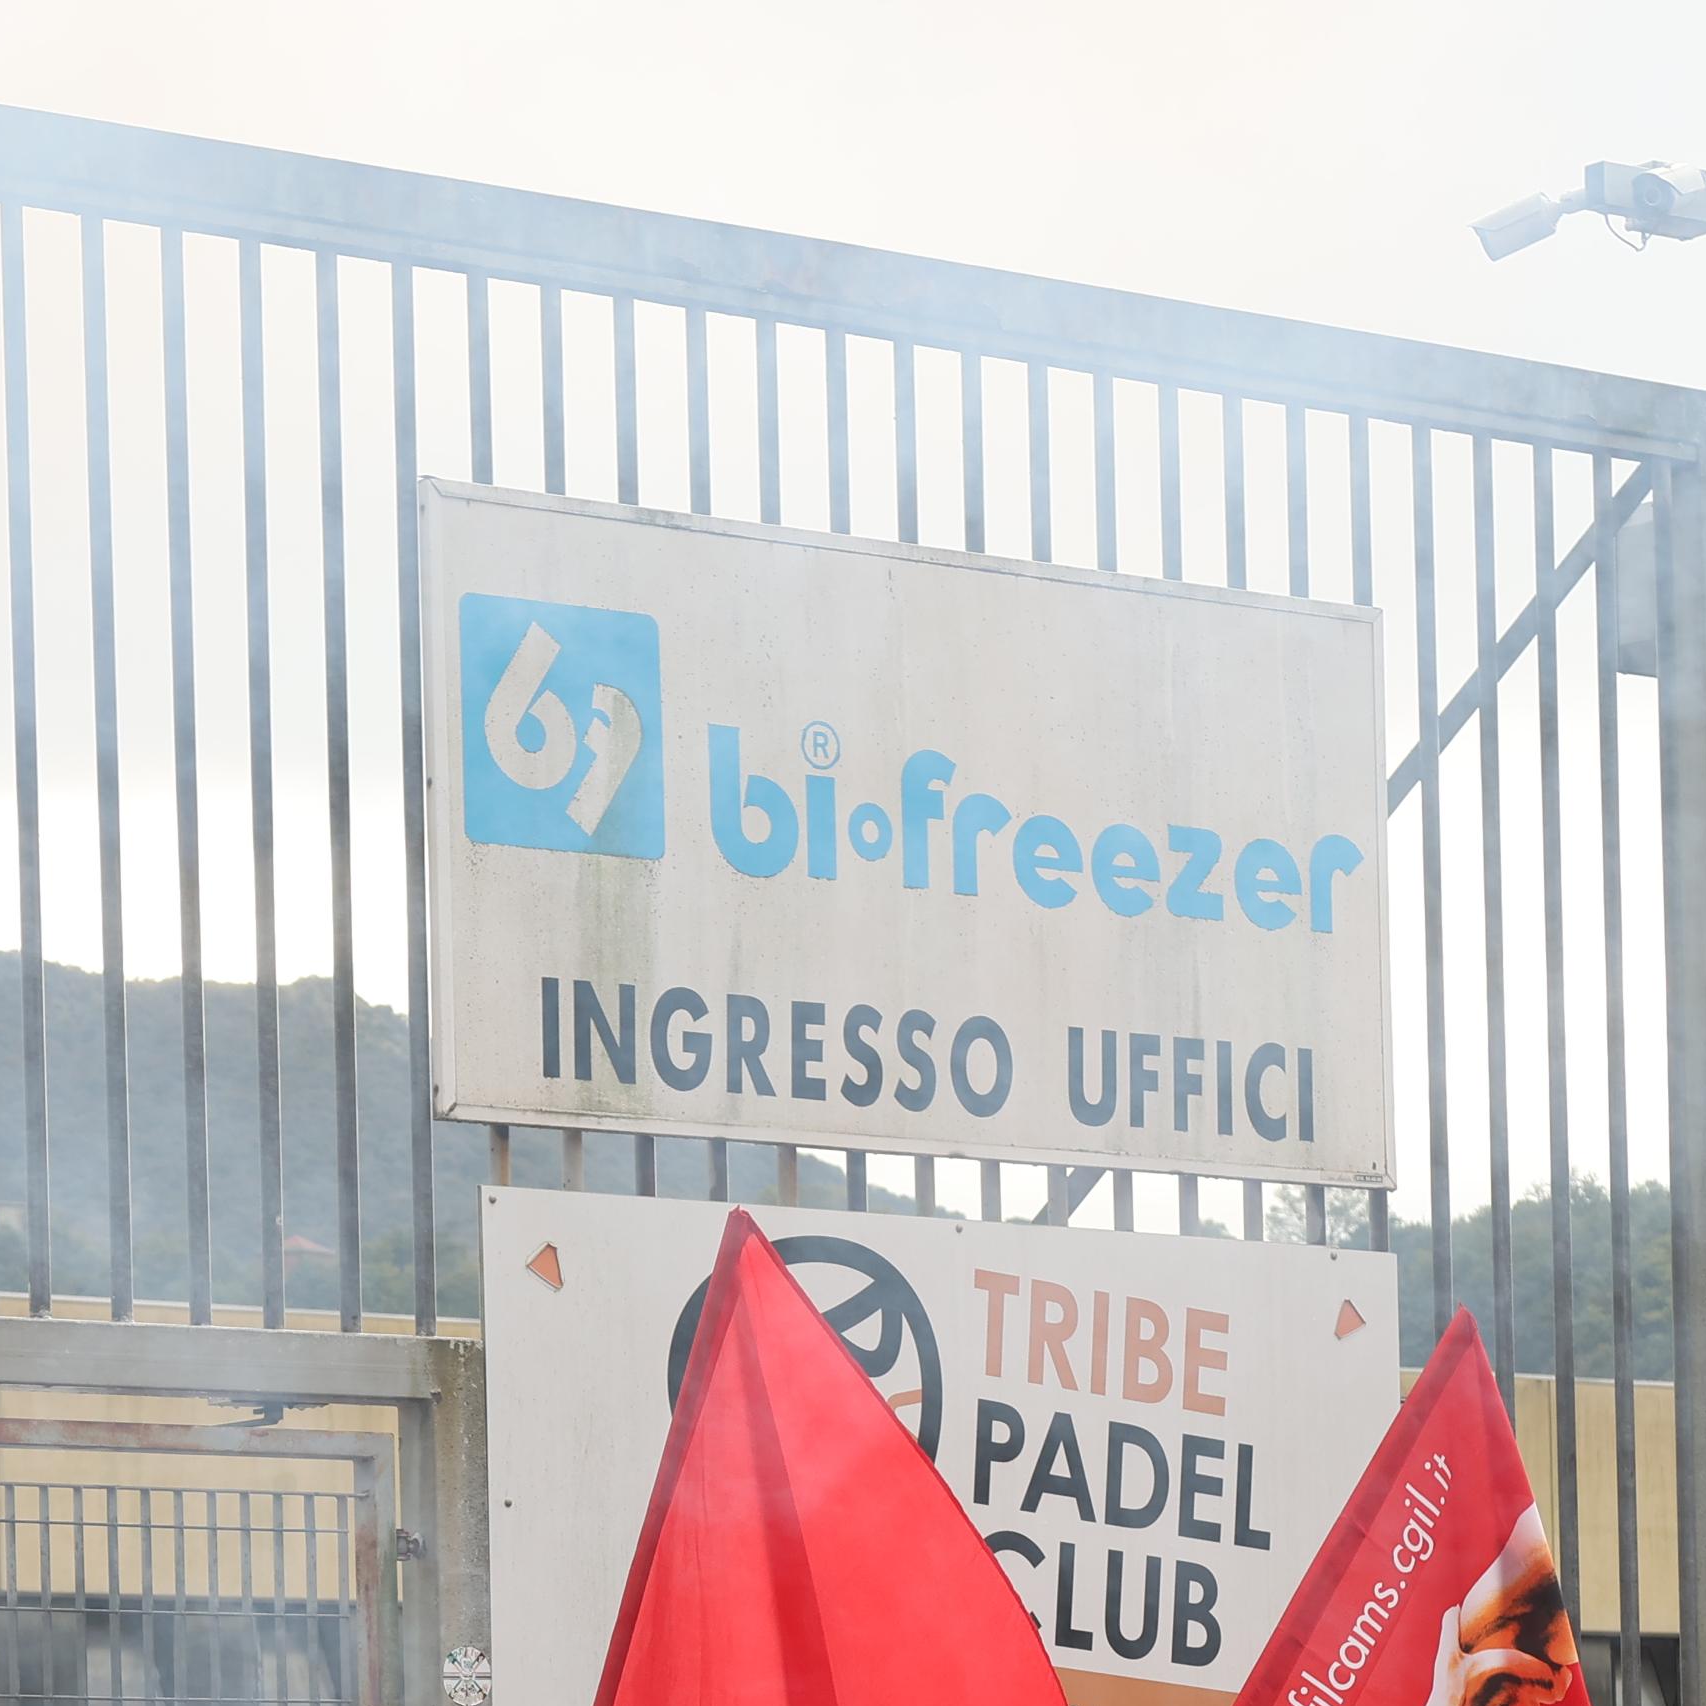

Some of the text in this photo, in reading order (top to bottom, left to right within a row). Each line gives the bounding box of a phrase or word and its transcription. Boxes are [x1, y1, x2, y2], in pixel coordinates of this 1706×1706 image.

[540, 977, 1315, 1143] INGRESSO UFFICI
[973, 1267, 1230, 1417] TRIBE
[973, 1398, 1272, 1552] PADEL
